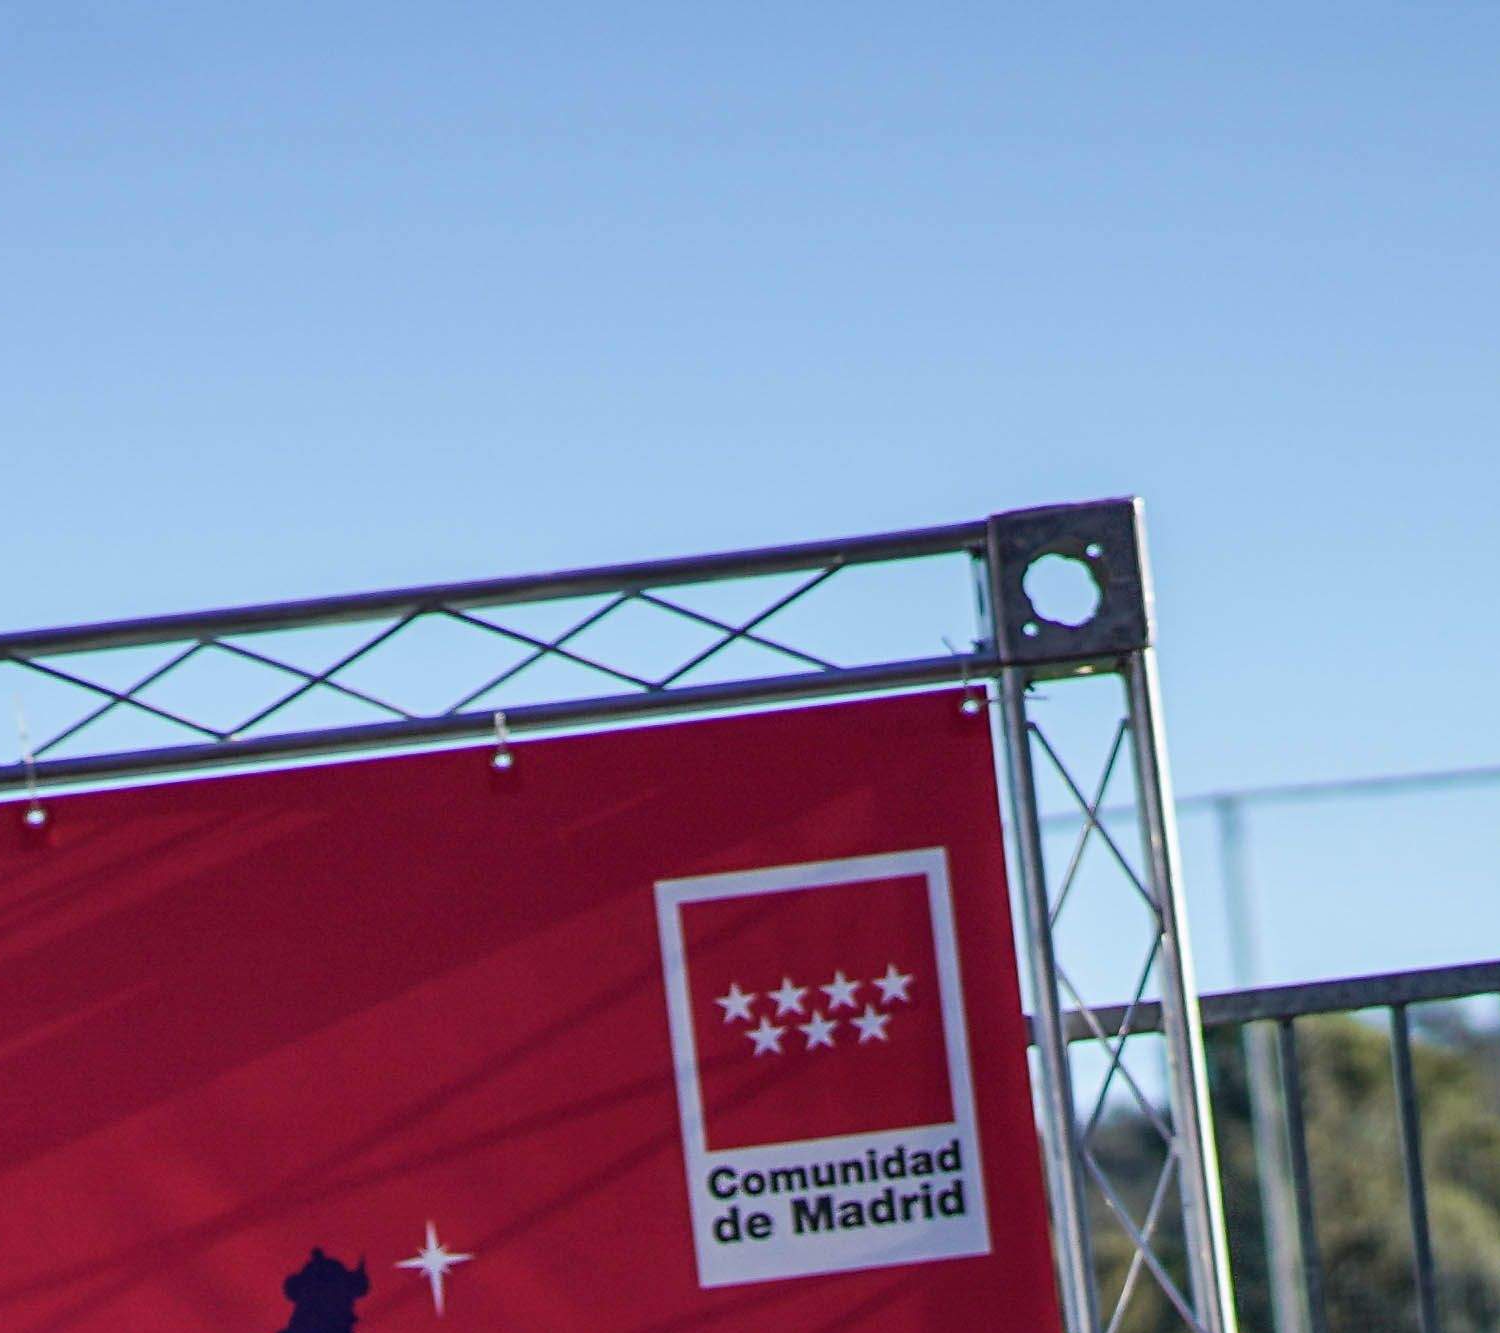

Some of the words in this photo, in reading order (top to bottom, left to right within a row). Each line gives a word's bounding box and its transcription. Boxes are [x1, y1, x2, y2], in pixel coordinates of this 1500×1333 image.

[708, 1138, 963, 1200] Comunidad
[713, 1206, 772, 1244] de
[791, 1180, 966, 1235] Madrid
